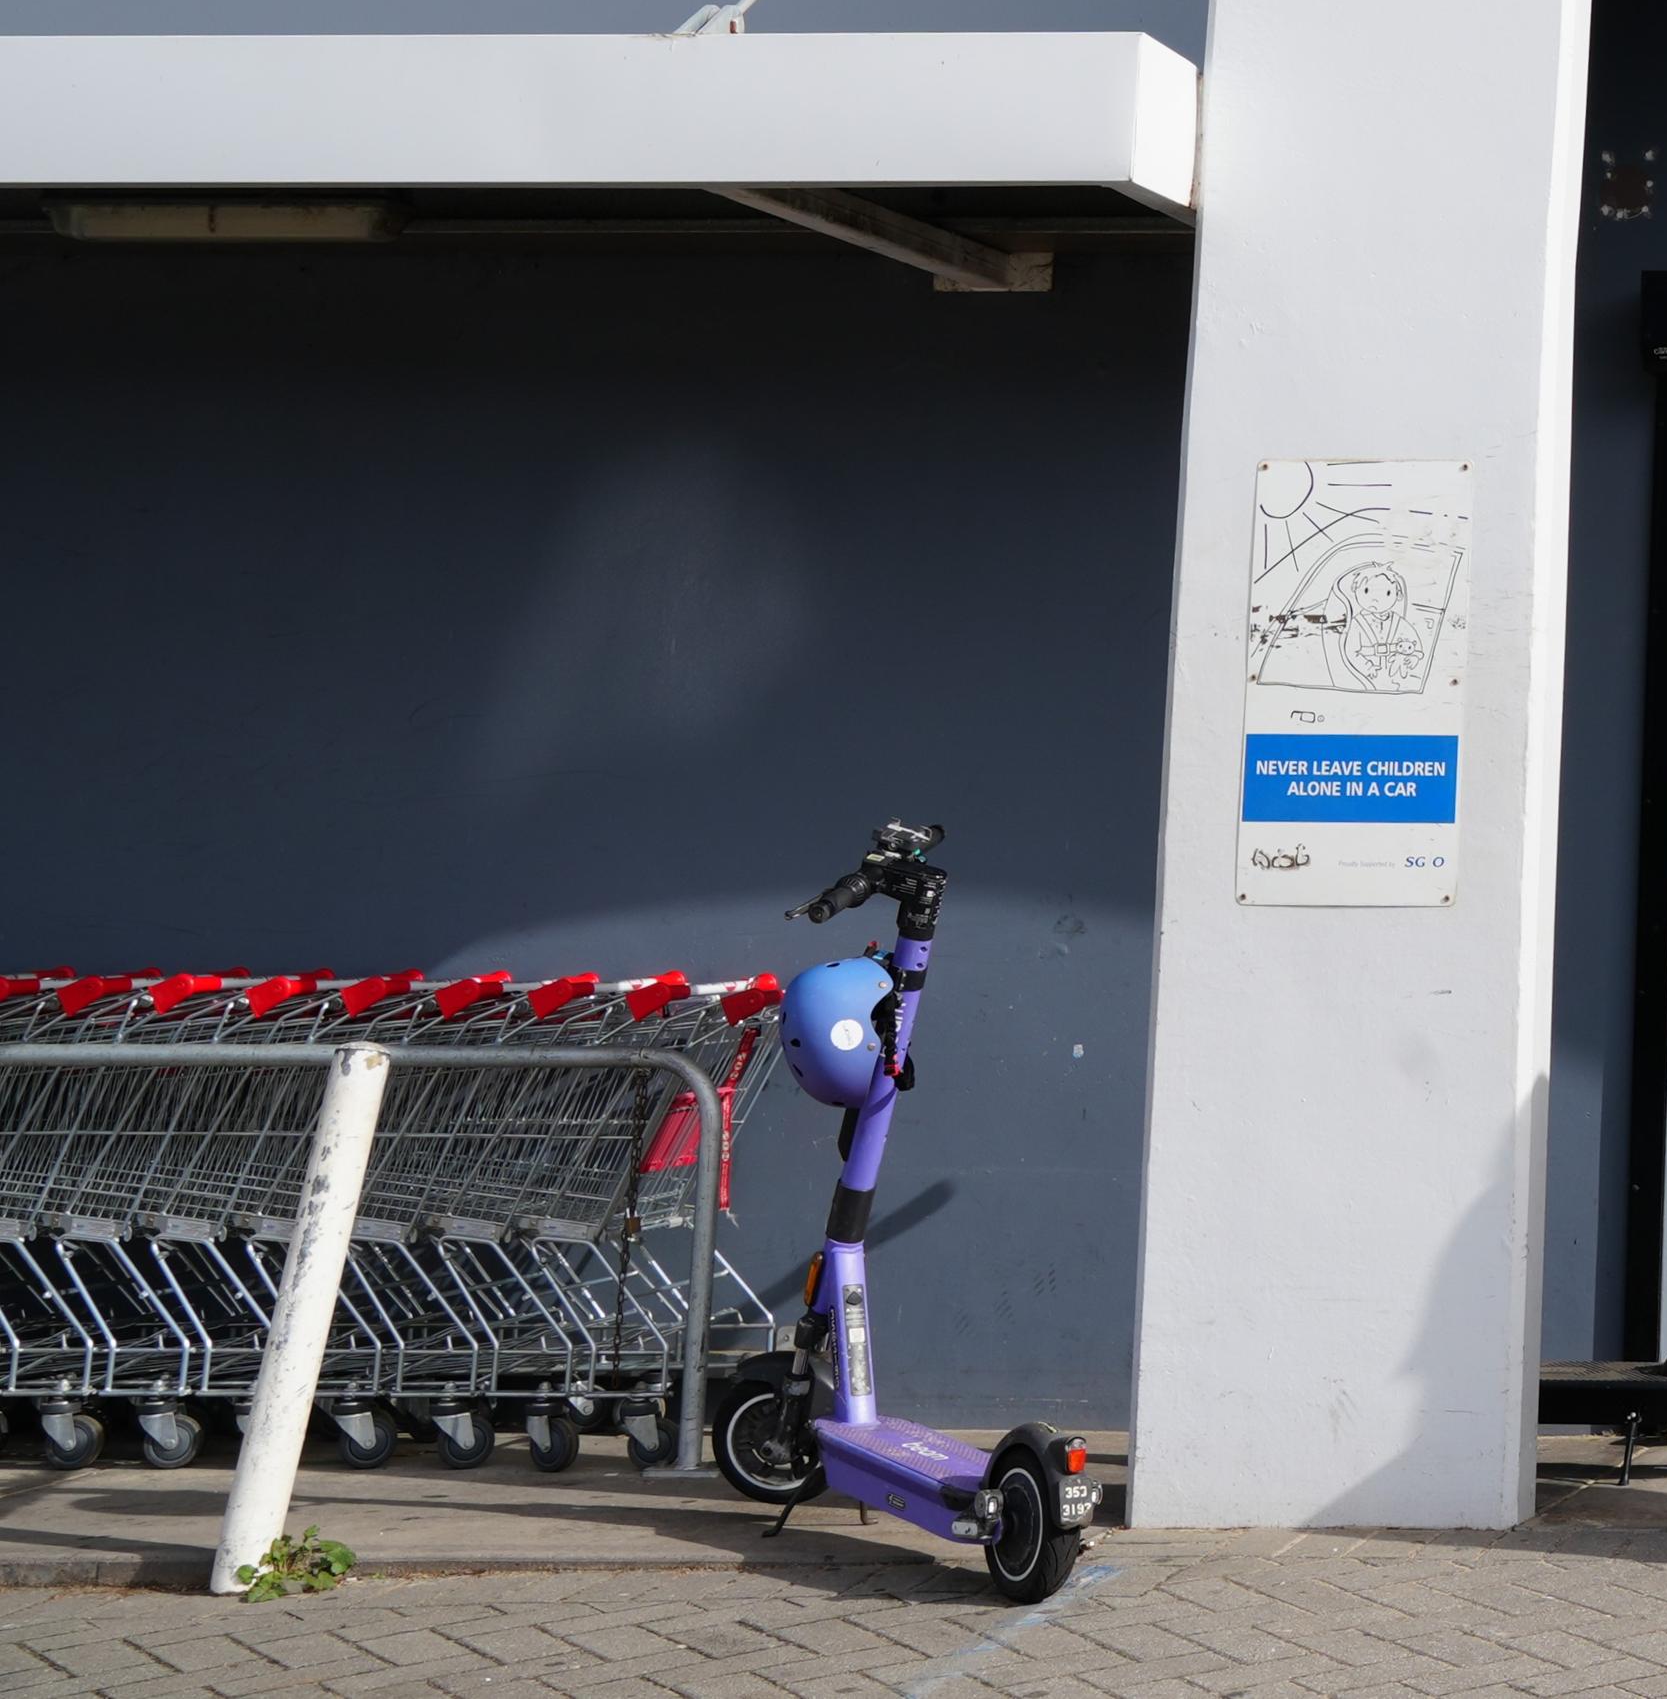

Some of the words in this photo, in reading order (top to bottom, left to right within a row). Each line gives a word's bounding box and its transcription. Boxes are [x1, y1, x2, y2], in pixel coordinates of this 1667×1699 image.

[1256, 761, 1308, 776] NEVER
[1313, 761, 1362, 777] LEAVE
[1366, 761, 1446, 777] CHILDREN
[1286, 781, 1342, 797] ALONE
[1346, 781, 1364, 797] IN
[1368, 781, 1381, 797] A
[1385, 781, 1417, 798] CAR
